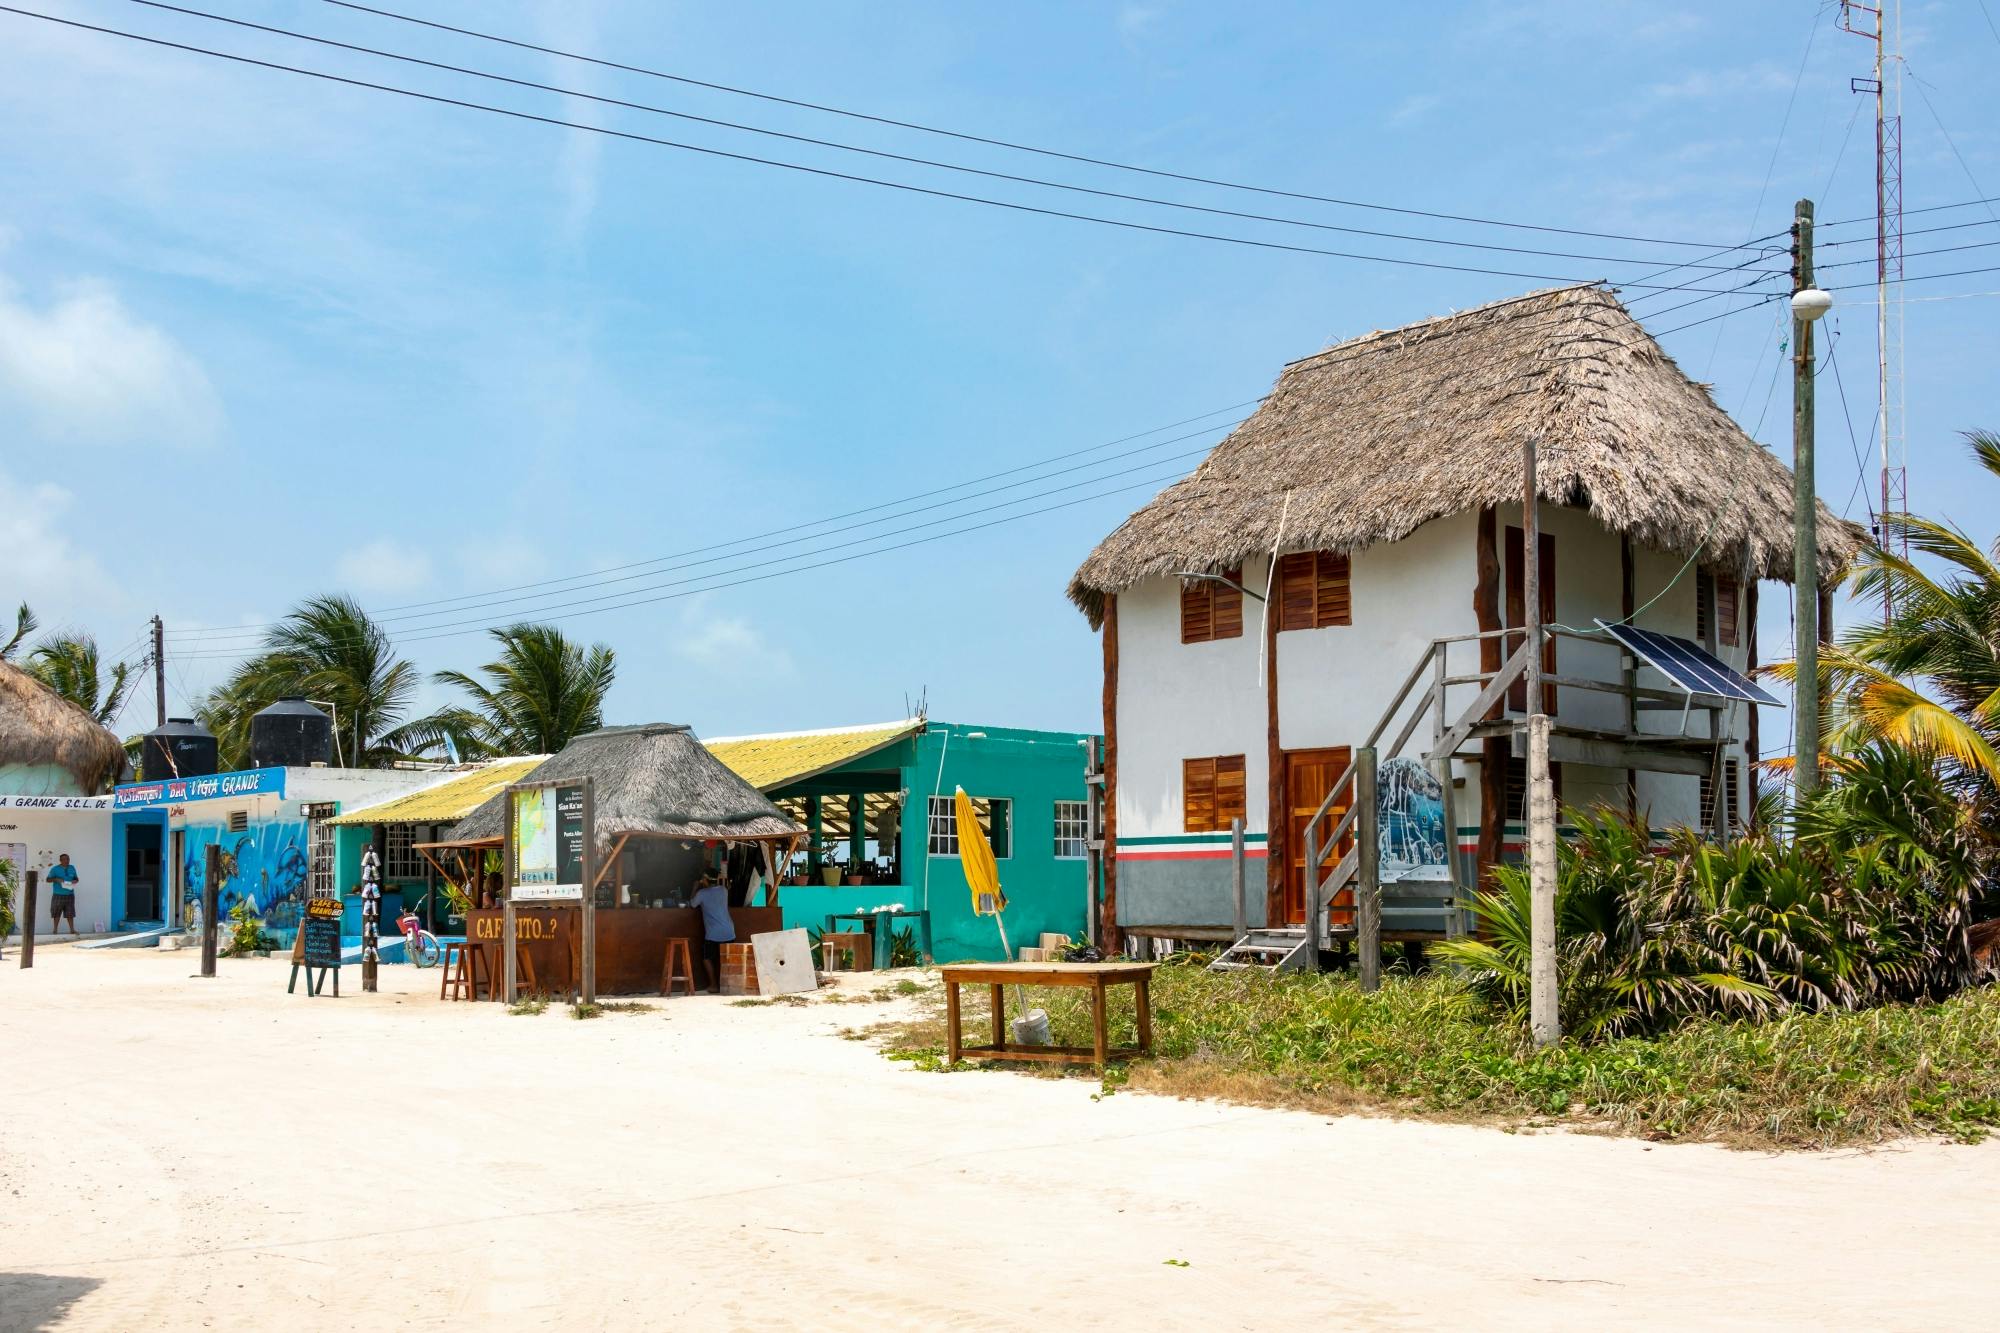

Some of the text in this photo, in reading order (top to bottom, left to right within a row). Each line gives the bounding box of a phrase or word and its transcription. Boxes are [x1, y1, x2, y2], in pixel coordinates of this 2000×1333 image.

[168, 782, 188, 800] BAR
[16, 798, 58, 807] GRANDE
[95, 800, 107, 808] DE
[310, 906, 332, 915] GRANO
